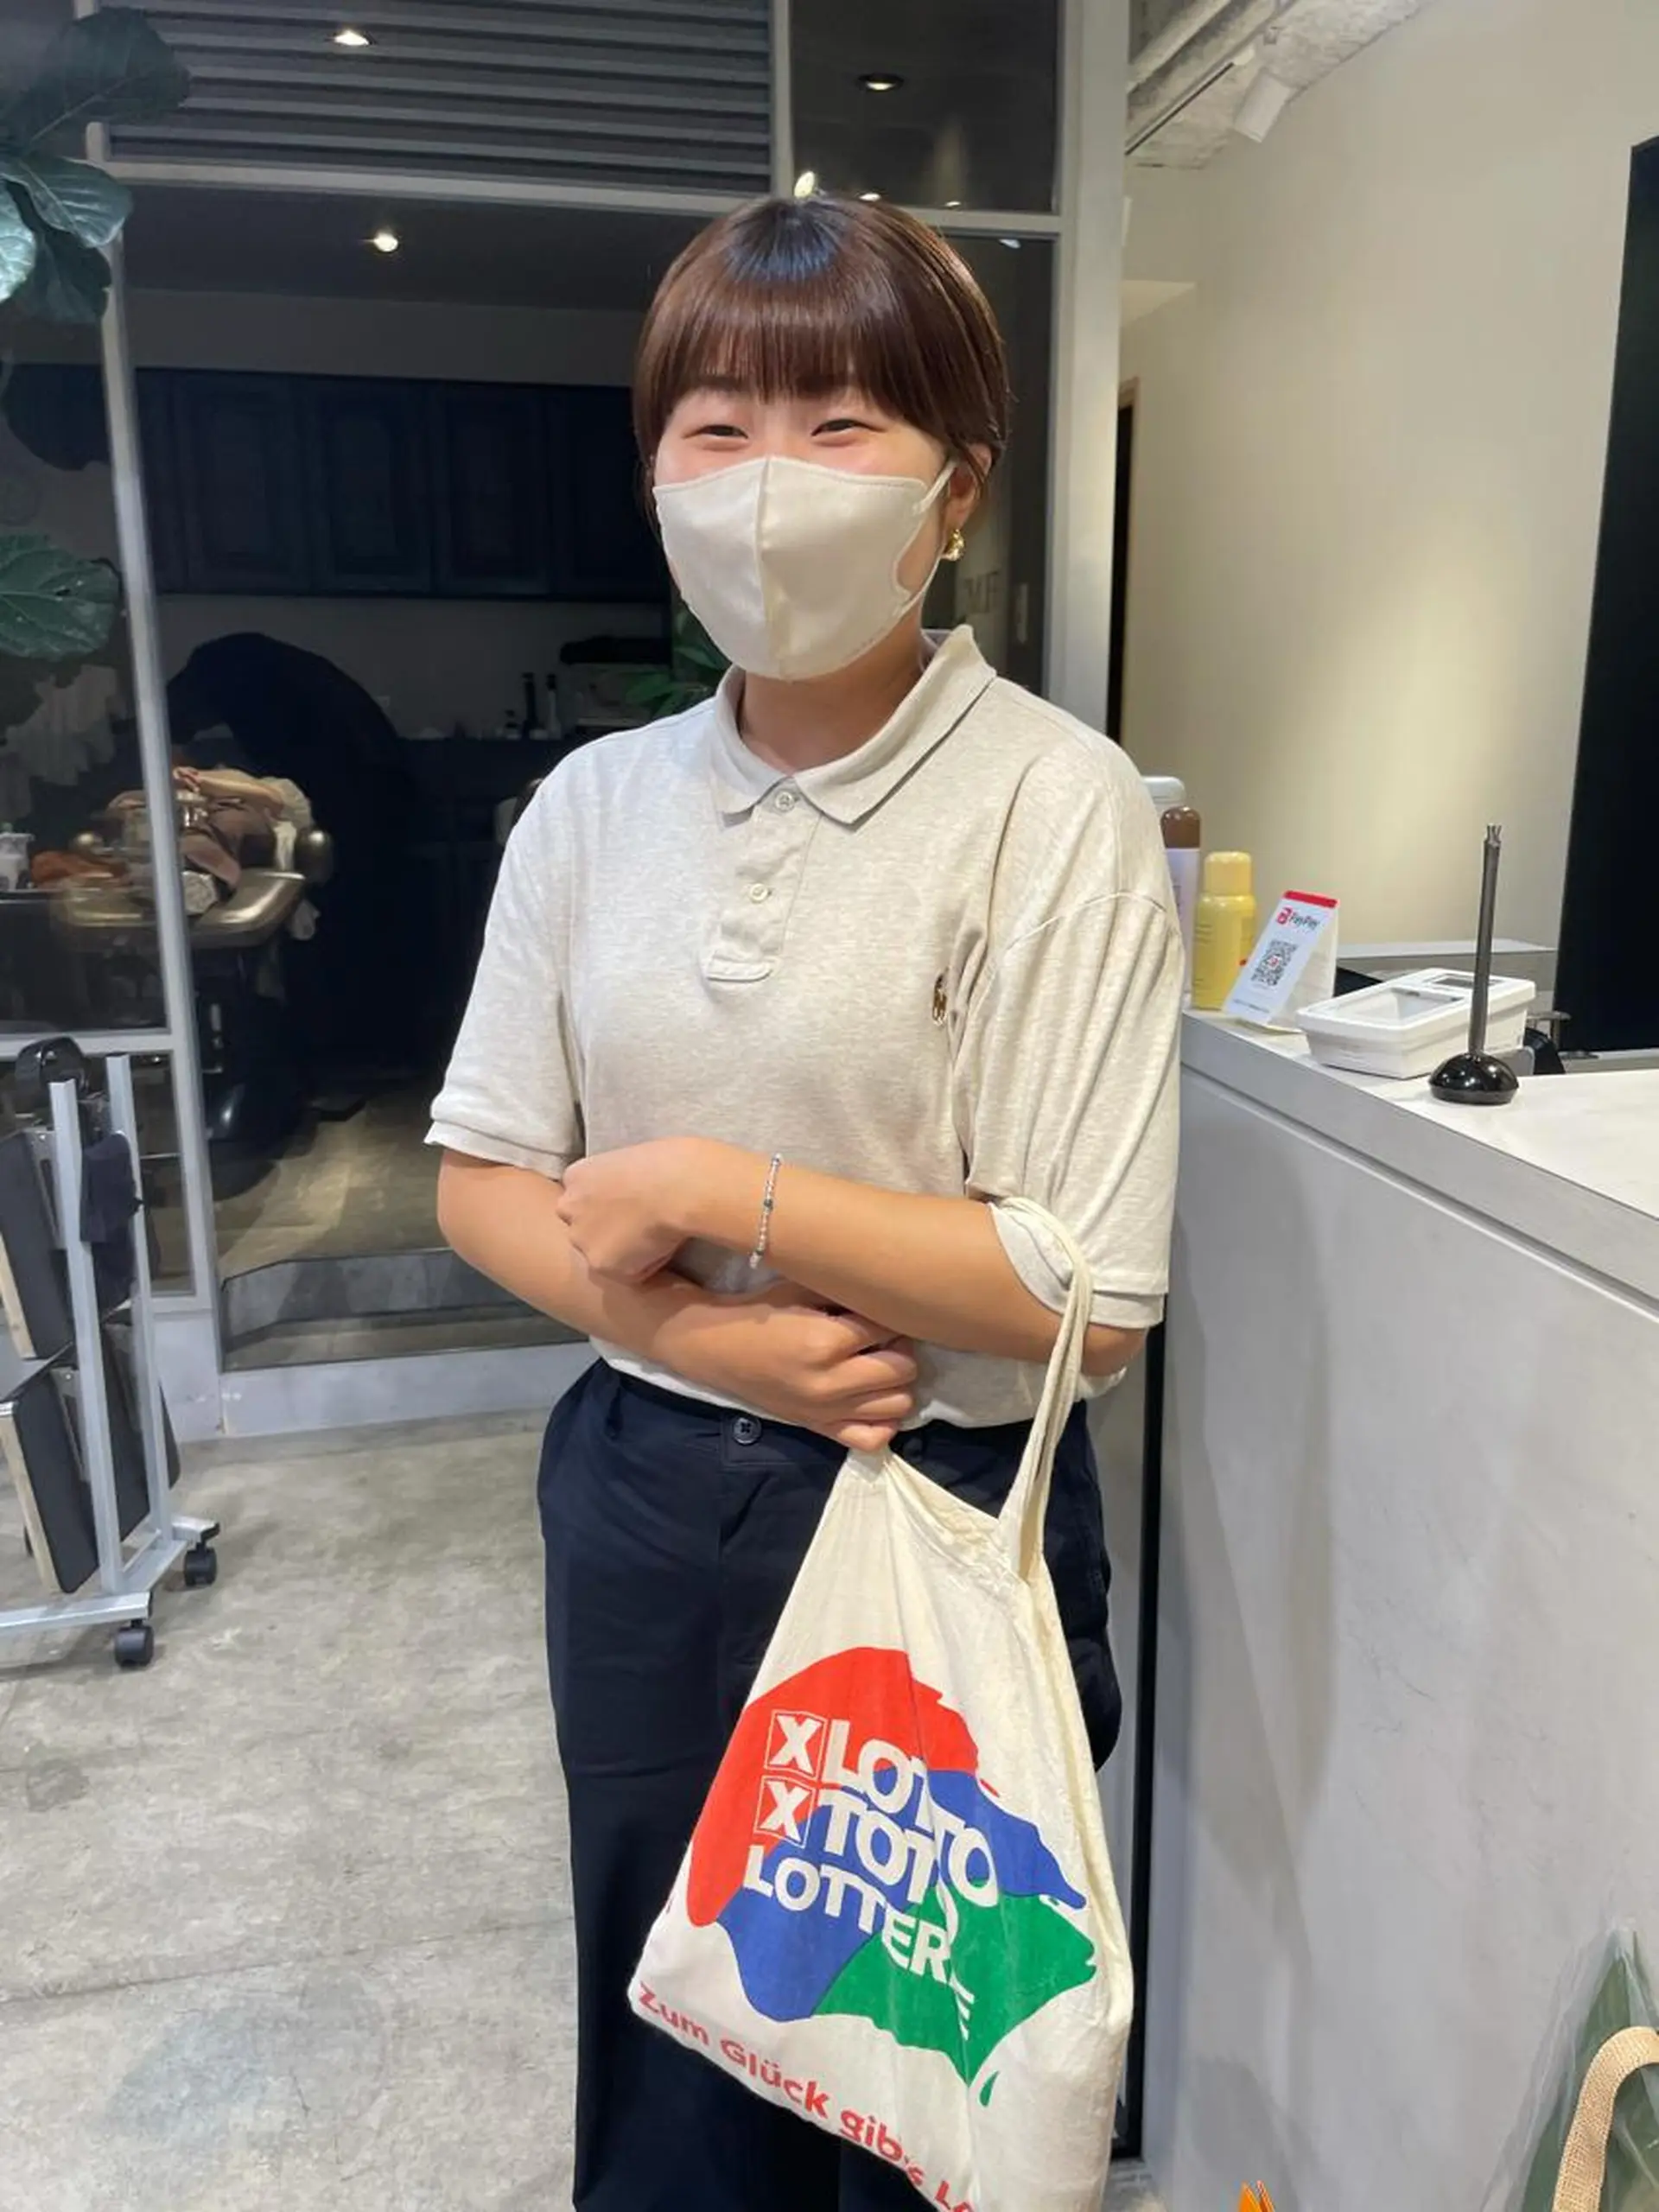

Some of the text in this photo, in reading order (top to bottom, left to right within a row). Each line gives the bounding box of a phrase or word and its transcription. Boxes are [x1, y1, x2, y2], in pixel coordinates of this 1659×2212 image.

[822, 1719, 999, 1907] LOTTO
[639, 1980, 709, 2046] Zum
[721, 2040, 829, 2119] Glück
